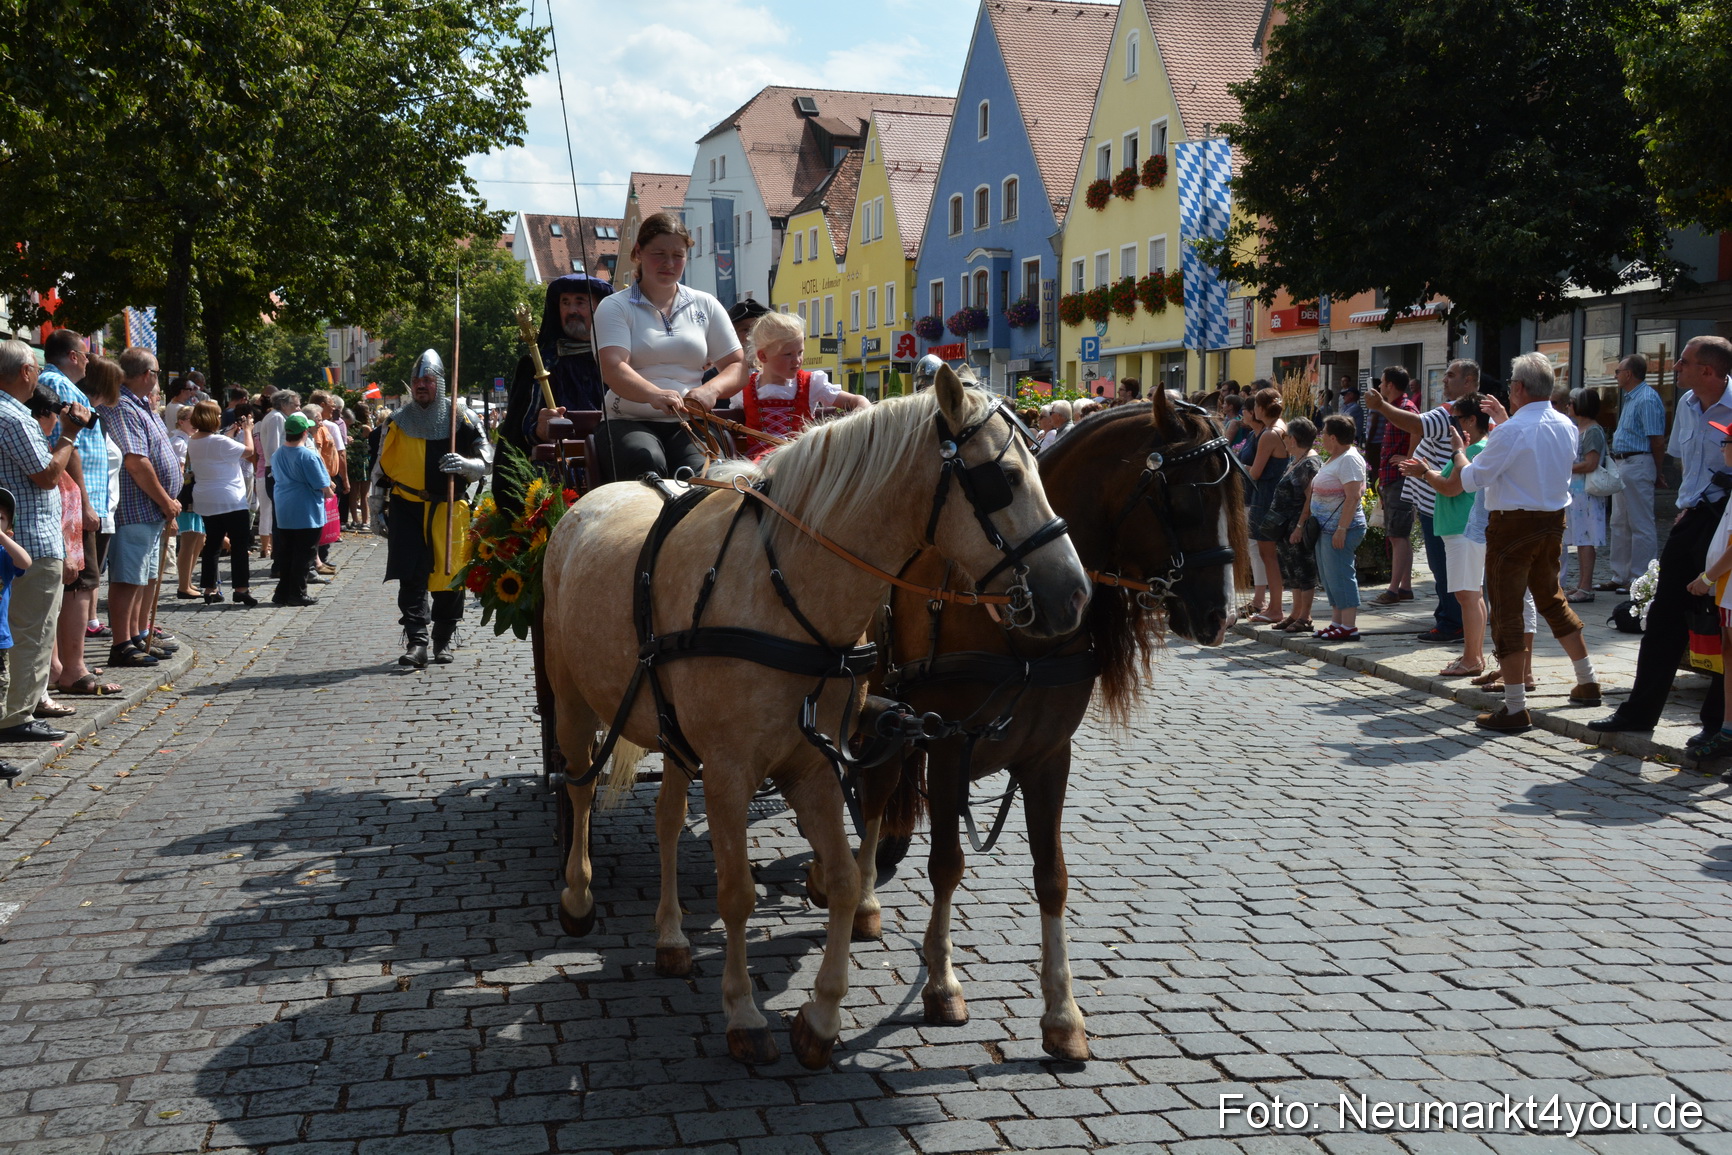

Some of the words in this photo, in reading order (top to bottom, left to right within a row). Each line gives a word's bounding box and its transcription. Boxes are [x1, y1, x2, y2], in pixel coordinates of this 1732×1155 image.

[801, 278, 819, 295] HOTEL
[1043, 292, 1053, 342] WITTL
[1085, 340, 1096, 360] P
